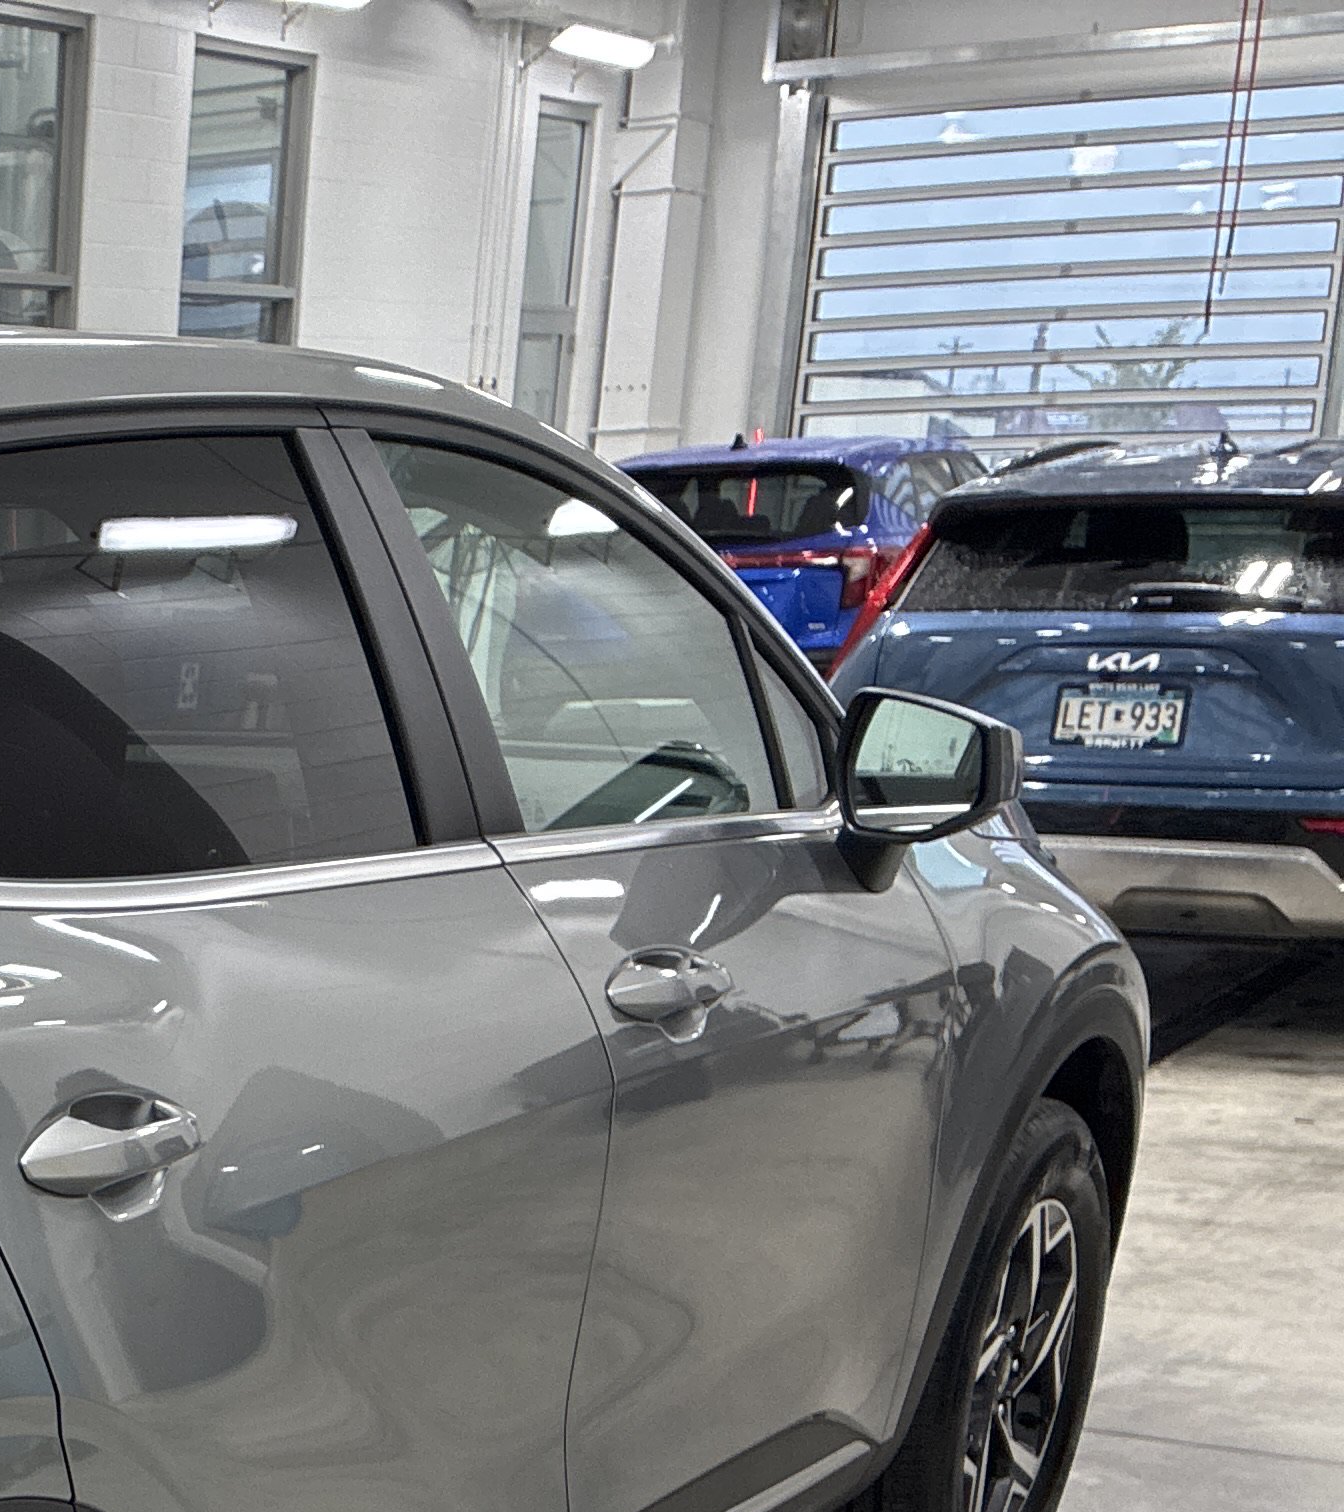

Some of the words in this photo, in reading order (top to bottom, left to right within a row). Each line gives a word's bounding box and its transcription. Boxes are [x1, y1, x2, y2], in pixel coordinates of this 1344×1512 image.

[1087, 652, 1160, 672] KIA
[1061, 699, 1111, 731] LET
[1130, 701, 1179, 731] 933
